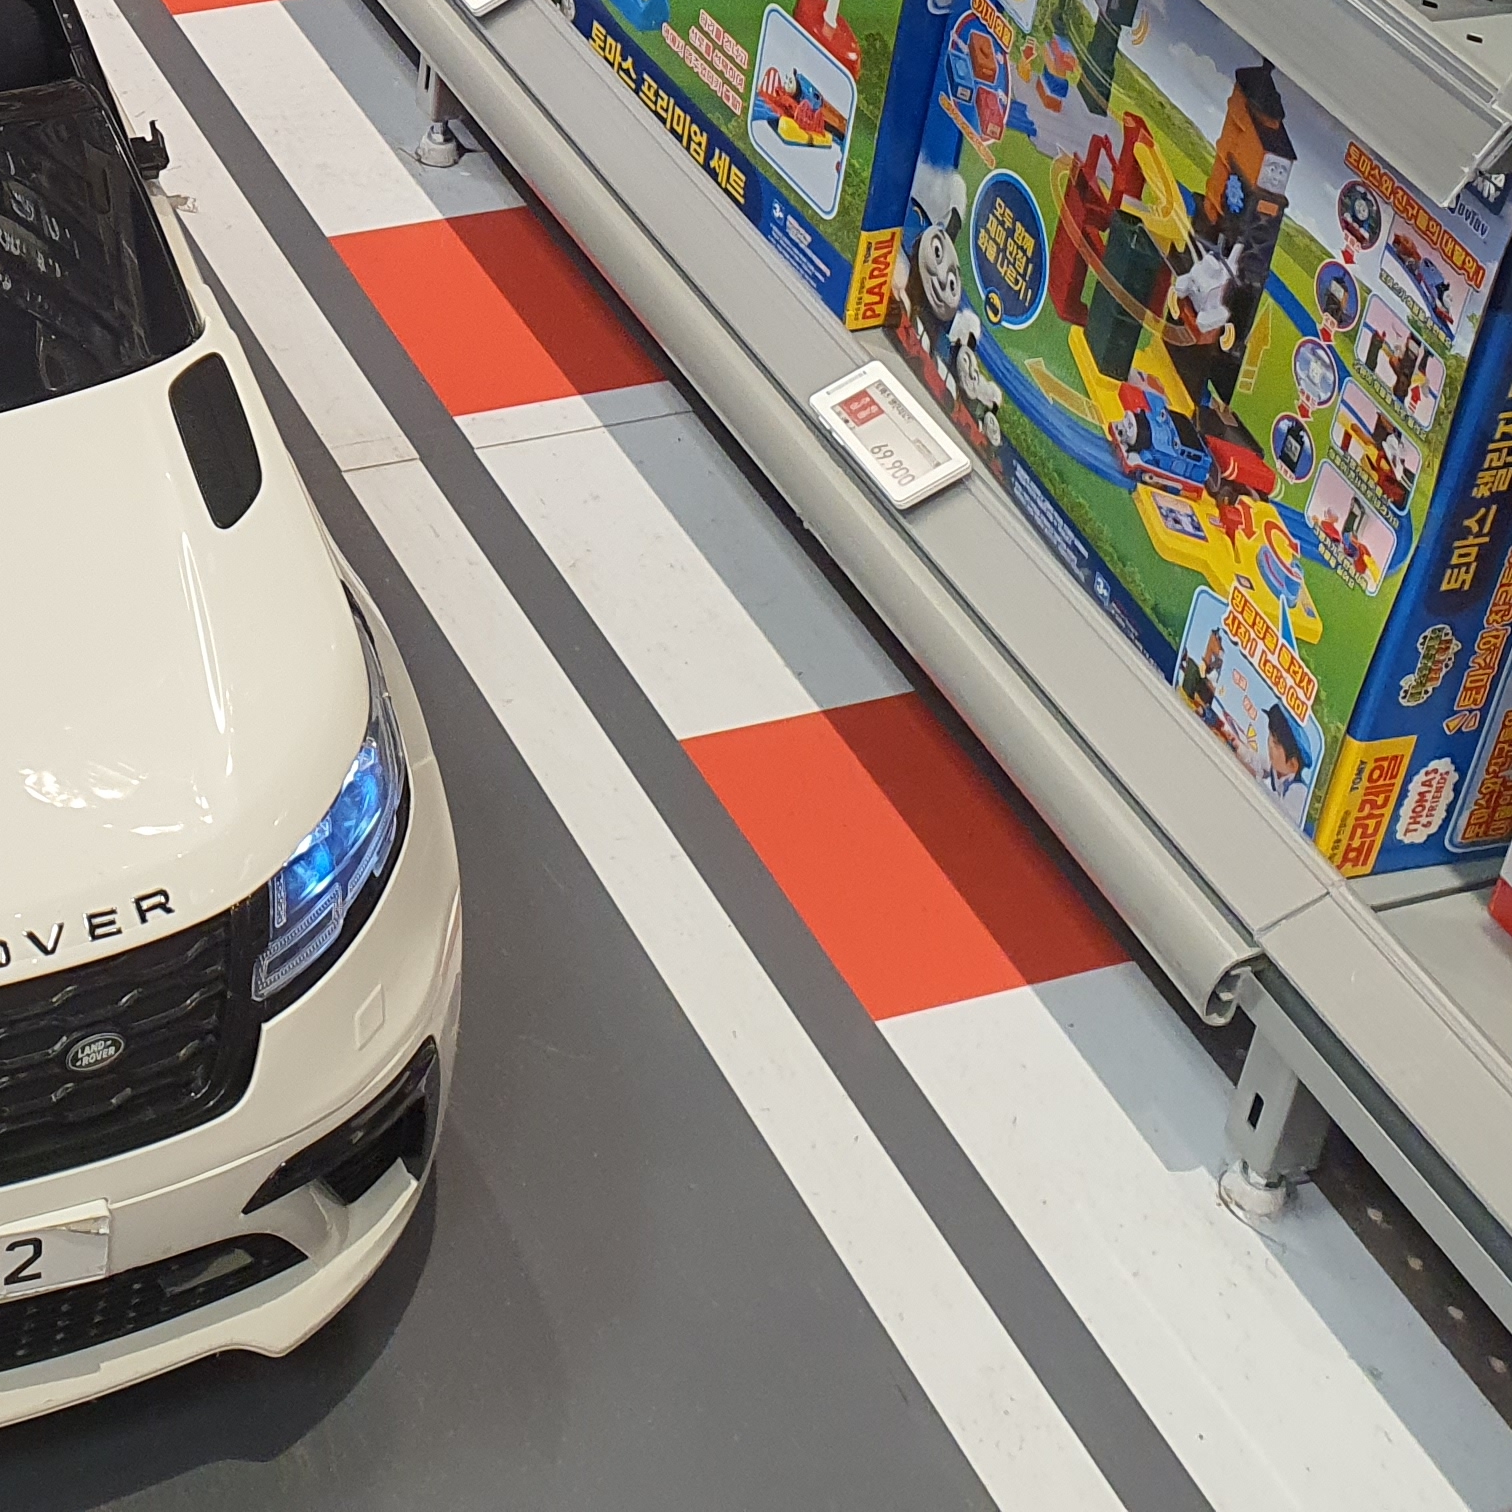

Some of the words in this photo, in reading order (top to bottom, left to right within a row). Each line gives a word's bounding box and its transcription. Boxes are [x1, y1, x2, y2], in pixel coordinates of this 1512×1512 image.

[589, 19, 637, 87] 토마스
[640, 72, 708, 165] 프리미엄
[708, 142, 747, 204] 세트
[994, 196, 1013, 228] 모두
[1346, 144, 1394, 202] 토마스와
[1392, 185, 1442, 247] 친구들의
[986, 217, 1007, 247] 재미
[861, 231, 896, 321] PLARAIL
[869, 442, 916, 487] 69,900
[1441, 503, 1497, 591] 토마스
[1230, 586, 1280, 656] 빙글빙글
[1277, 639, 1317, 702] 돌려서
[1352, 759, 1367, 792] TOMY
[1402, 766, 1439, 837] THOMAS
[1423, 771, 1450, 819] FRIENDS
[1343, 752, 1404, 869] 프라레일
[77, 1039, 104, 1059] LAND
[81, 1046, 115, 1065] ROVER
